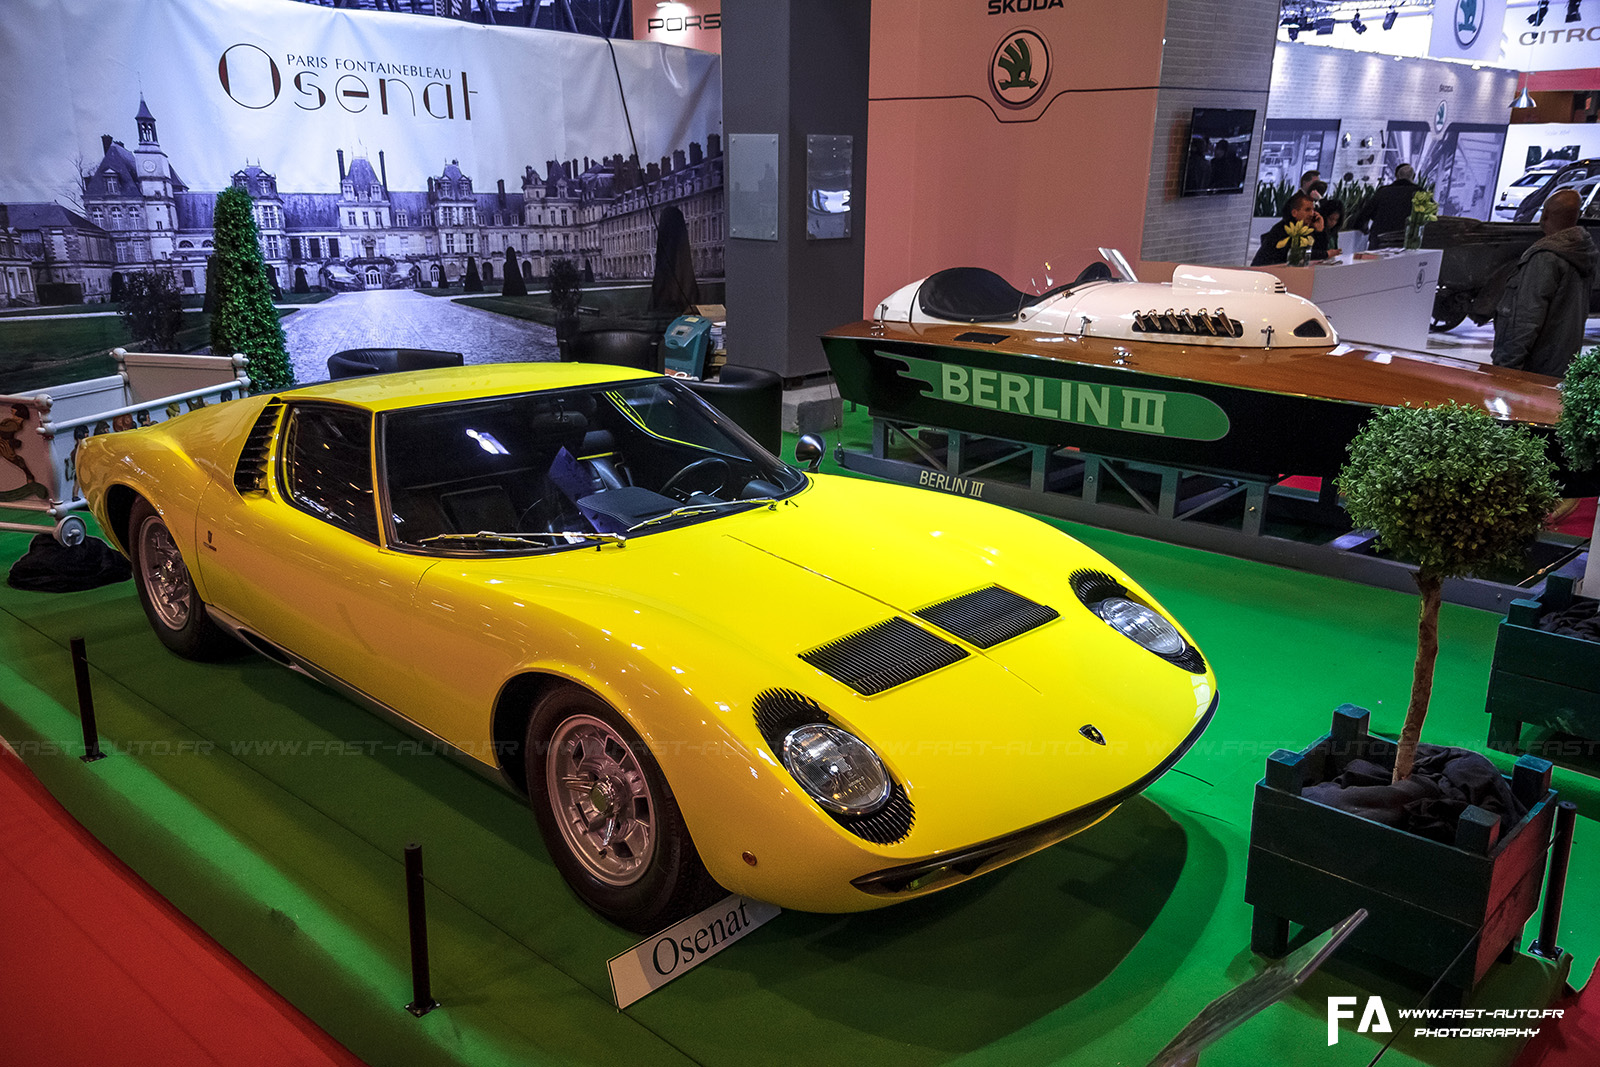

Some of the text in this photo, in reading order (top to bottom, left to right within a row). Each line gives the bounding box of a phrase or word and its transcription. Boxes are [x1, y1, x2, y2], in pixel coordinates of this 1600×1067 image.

[647, 13, 721, 33] PORS
[218, 43, 478, 121] Osenat
[286, 53, 452, 80] PARIS FONTAINEBLEAU
[941, 362, 1167, 434] BERLIN III
[919, 470, 985, 499] BERLIN III
[652, 898, 750, 976] Osenat
